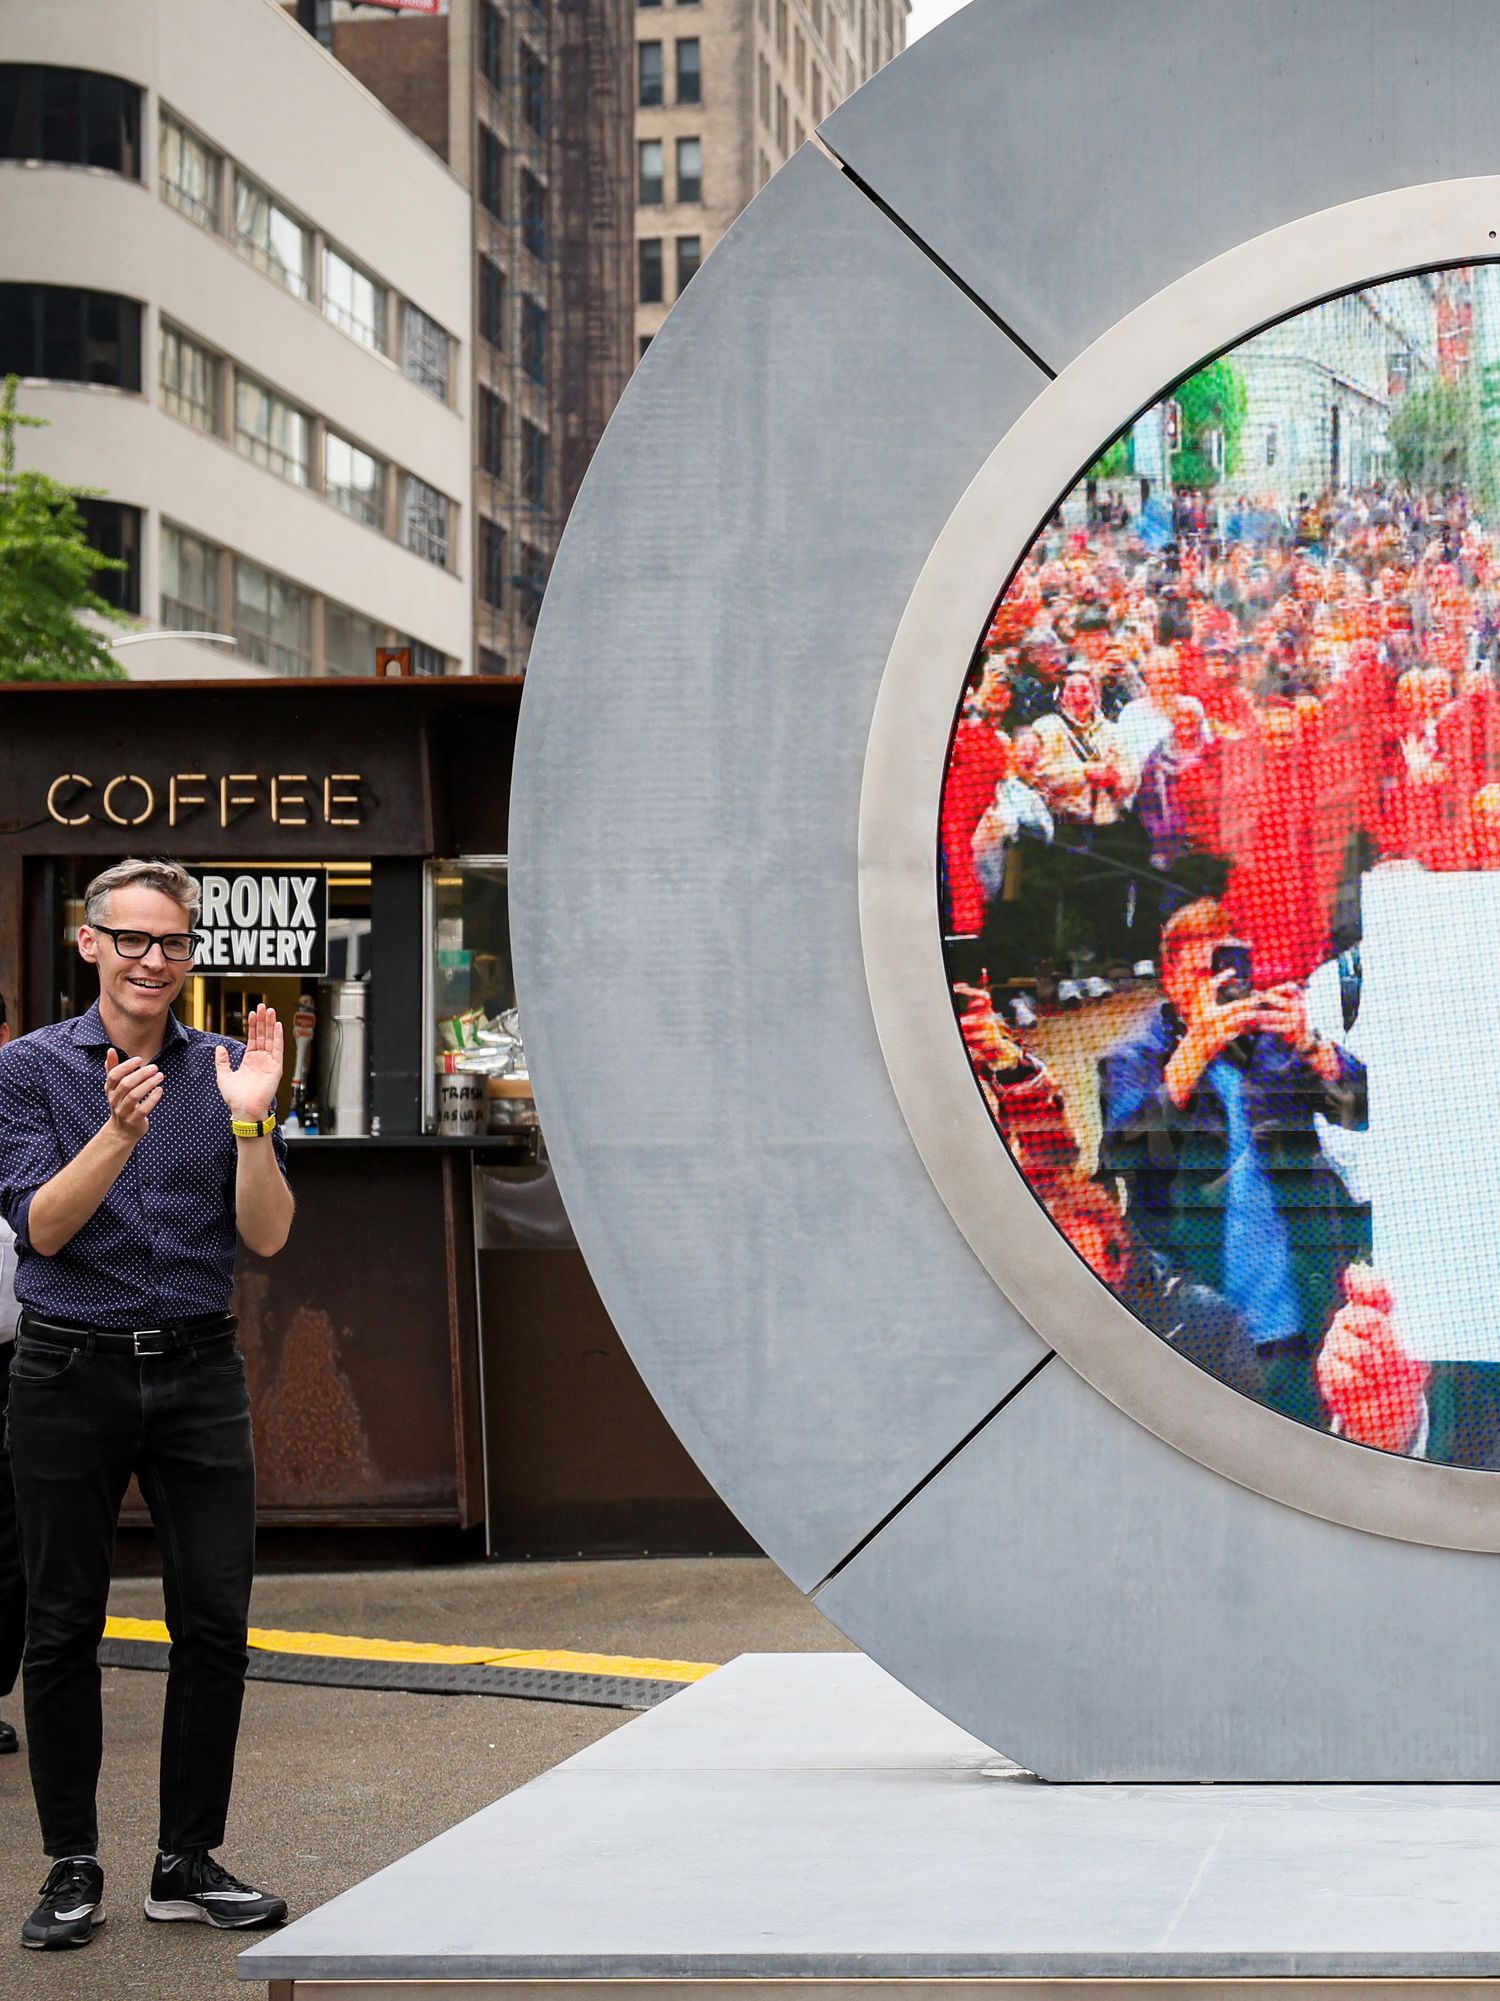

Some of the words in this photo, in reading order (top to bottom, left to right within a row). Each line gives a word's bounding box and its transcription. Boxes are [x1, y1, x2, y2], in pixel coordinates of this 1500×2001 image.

[47, 774, 361, 828] COFFEE
[190, 875, 317, 928] RONX
[194, 929, 317, 966] REWERY
[441, 1086, 483, 1102] TRASH
